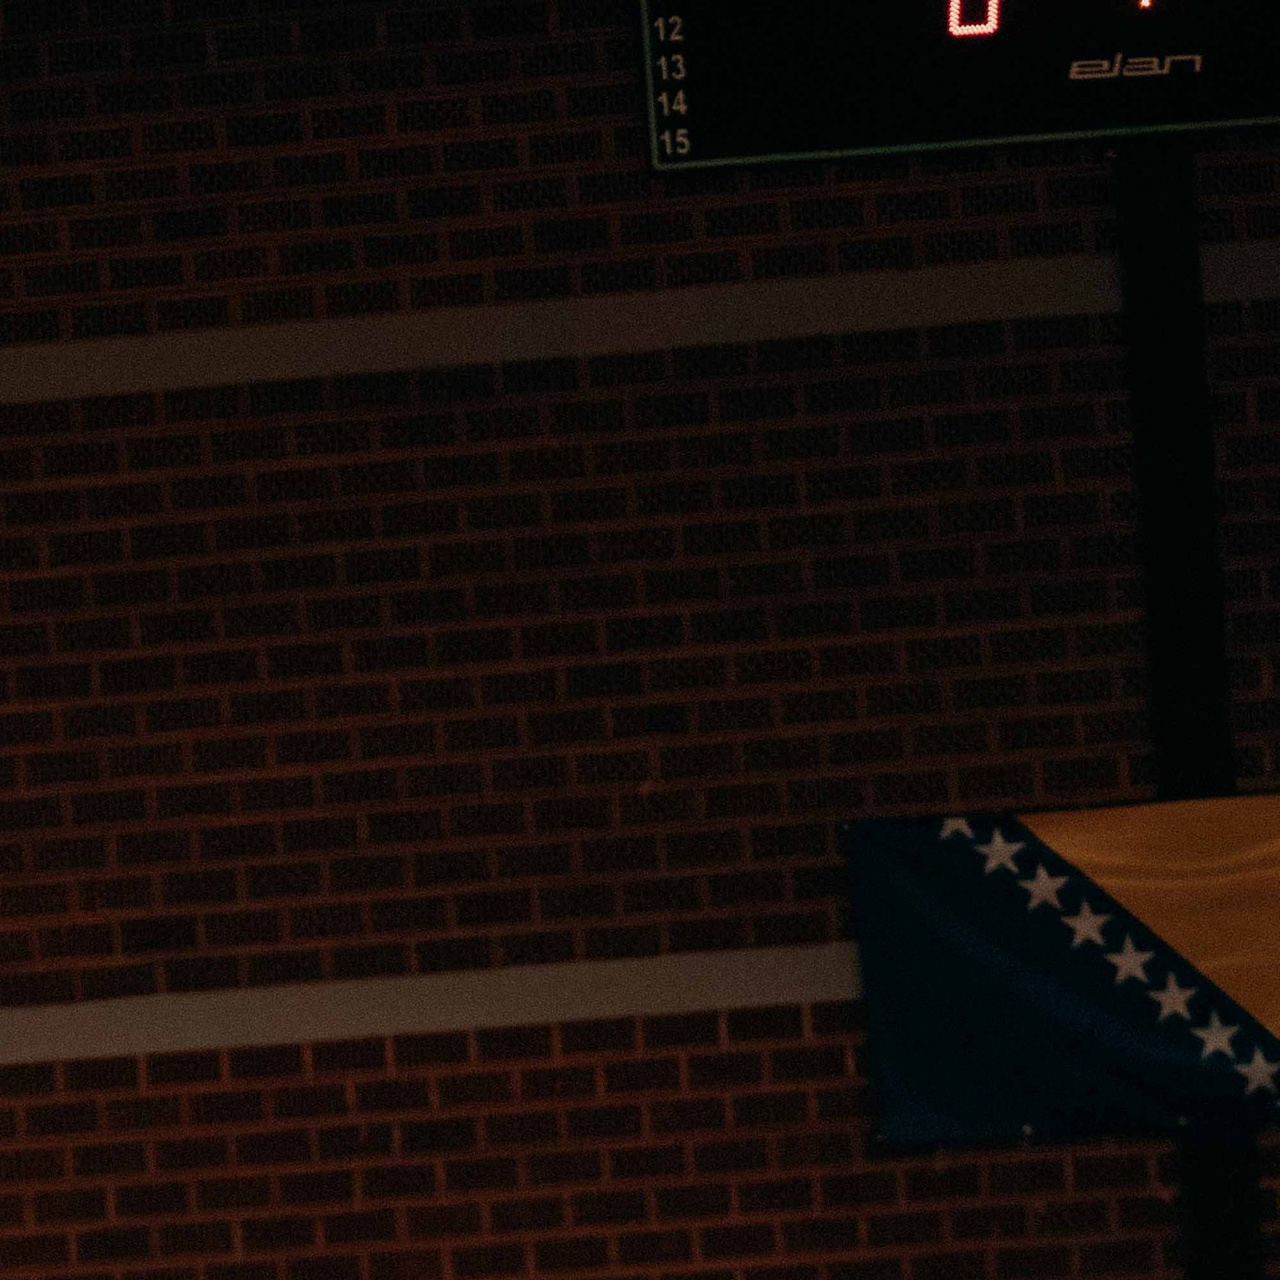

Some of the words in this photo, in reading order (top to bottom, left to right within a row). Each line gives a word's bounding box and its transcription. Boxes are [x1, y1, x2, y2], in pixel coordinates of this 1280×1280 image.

[654, 15, 684, 41] 12
[657, 54, 686, 80] 13
[658, 89, 688, 116] 14
[661, 128, 691, 155] 15
